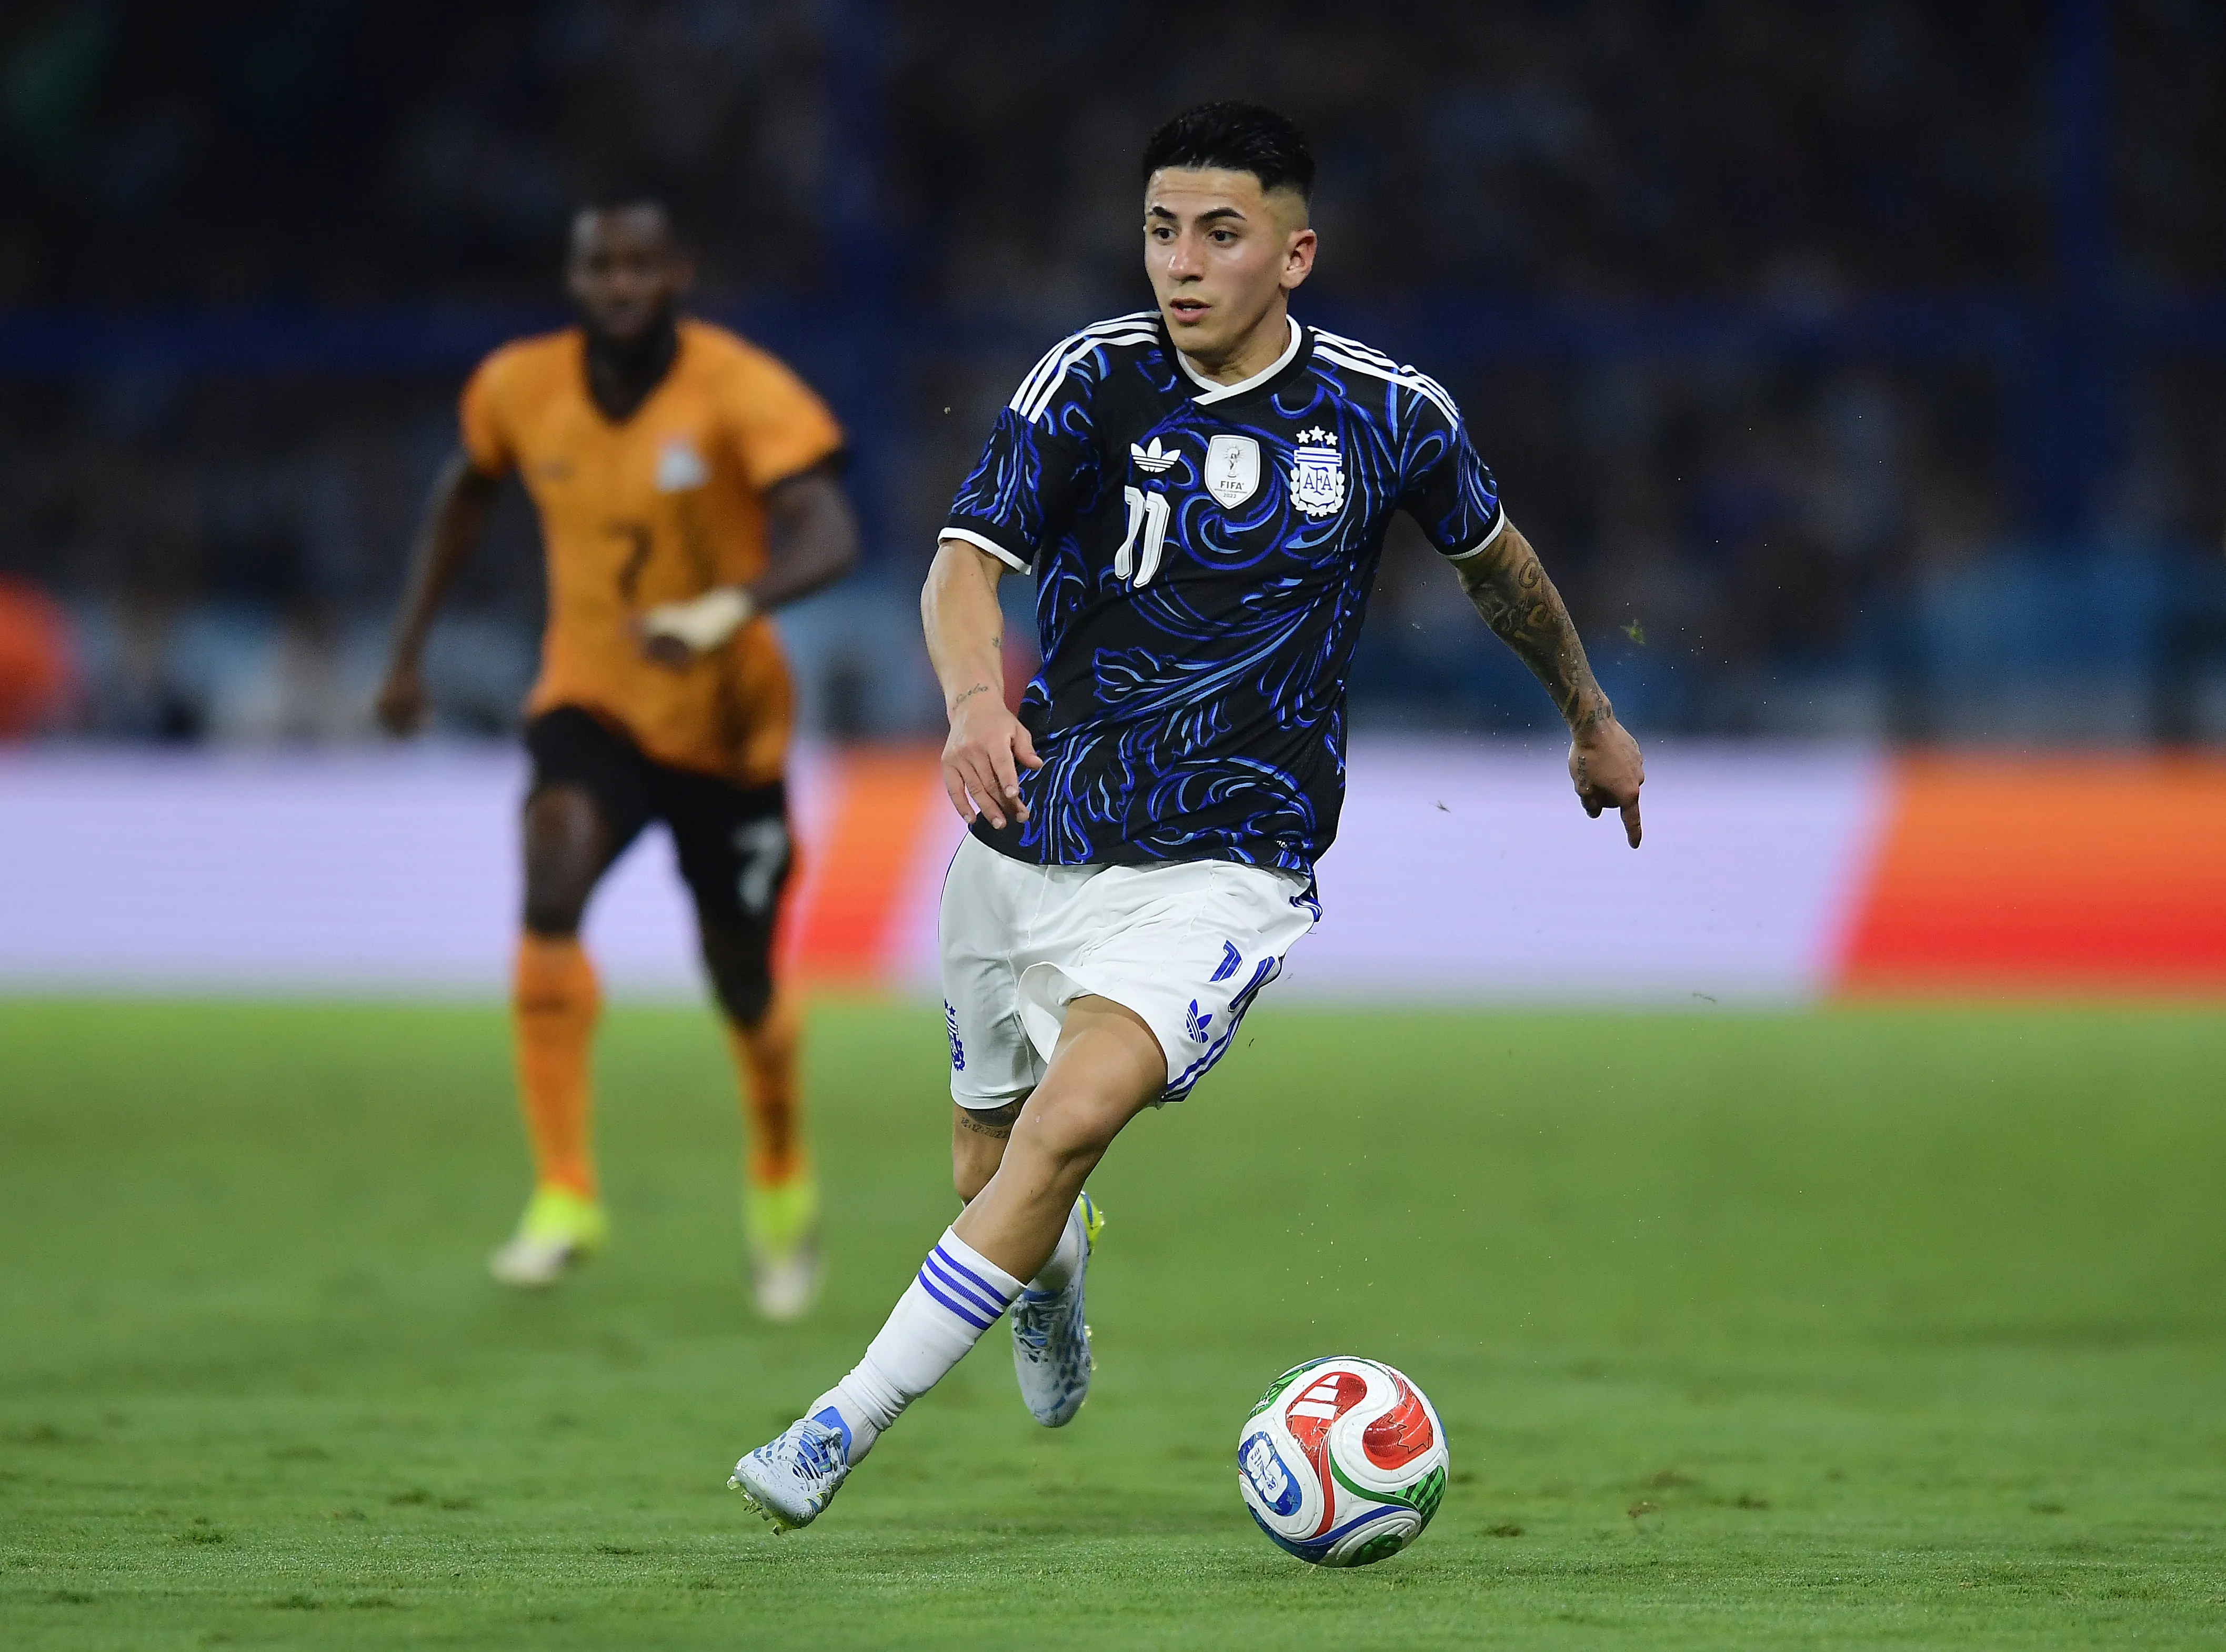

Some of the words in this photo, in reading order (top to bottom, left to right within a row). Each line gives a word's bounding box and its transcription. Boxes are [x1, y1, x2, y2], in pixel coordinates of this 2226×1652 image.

[1220, 481, 1242, 490] FIFA
[1303, 465, 1333, 496] AFA
[605, 518, 654, 605] 7
[1115, 485, 1170, 588] 11
[731, 821, 788, 911] 7
